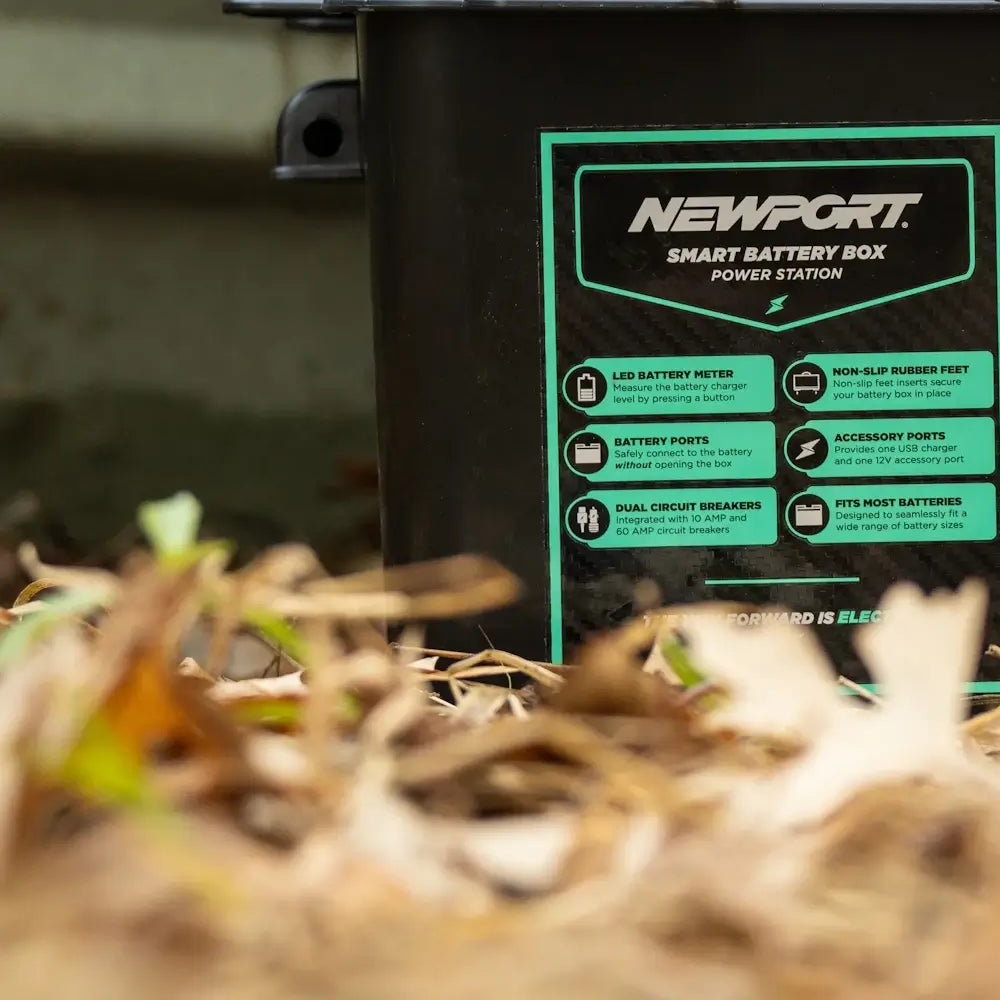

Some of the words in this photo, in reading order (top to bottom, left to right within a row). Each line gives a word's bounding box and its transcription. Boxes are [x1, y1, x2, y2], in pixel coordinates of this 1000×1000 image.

[667, 247, 741, 263] SMART
[743, 246, 840, 262] BATTERY
[839, 245, 887, 260] BOX
[711, 269, 771, 281] POWER
[776, 268, 843, 280] STATION
[613, 372, 635, 380] LED
[638, 371, 691, 380] BATTERY
[694, 370, 733, 378] METER
[833, 367, 888, 376] NON-SLIP
[891, 366, 937, 375] RUBBER
[941, 366, 969, 374] FEET
[613, 383, 652, 391] Measure
[674, 382, 708, 392] battery
[711, 382, 747, 391] charger
[833, 380, 872, 388] Non-slip
[876, 379, 893, 387] feet
[858, 391, 891, 399] battery
[895, 390, 912, 398] box
[927, 389, 951, 398] place
[614, 395, 634, 403] level
[638, 395, 649, 404] by
[653, 395, 691, 404] pressing
[615, 437, 667, 446] BATTERY
[671, 436, 709, 445] PORTS
[835, 433, 904, 442] ACCESSORY
[907, 432, 945, 440] PORTS
[615, 450, 643, 459] Safely
[700, 448, 715, 456] the
[719, 448, 752, 456] battery
[835, 445, 875, 453] Provides
[899, 444, 918, 452] USB
[921, 444, 957, 453] charger
[616, 461, 652, 469] without
[655, 461, 693, 469] opening
[944, 456, 964, 464] port
[616, 504, 647, 512] DUAL
[651, 503, 696, 511] CIRCUIT
[700, 502, 761, 510] BREAKERS
[836, 499, 860, 507] FITS
[864, 499, 896, 507] MOST
[899, 497, 962, 506] BATTERIES
[617, 516, 664, 525] Integrated
[668, 515, 688, 523] with
[705, 514, 726, 522] AMP
[729, 514, 747, 522] and
[836, 511, 880, 520] Designed
[896, 510, 945, 519] seamlessly
[949, 509, 958, 517] fit
[632, 527, 654, 535] AMP
[657, 526, 686, 534] circuit
[689, 526, 729, 534] breakers
[836, 523, 858, 531] wide
[904, 522, 938, 530] battery
[941, 521, 963, 529] sizes
[817, 611, 835, 625] IS
[837, 610, 890, 624] ELEC
